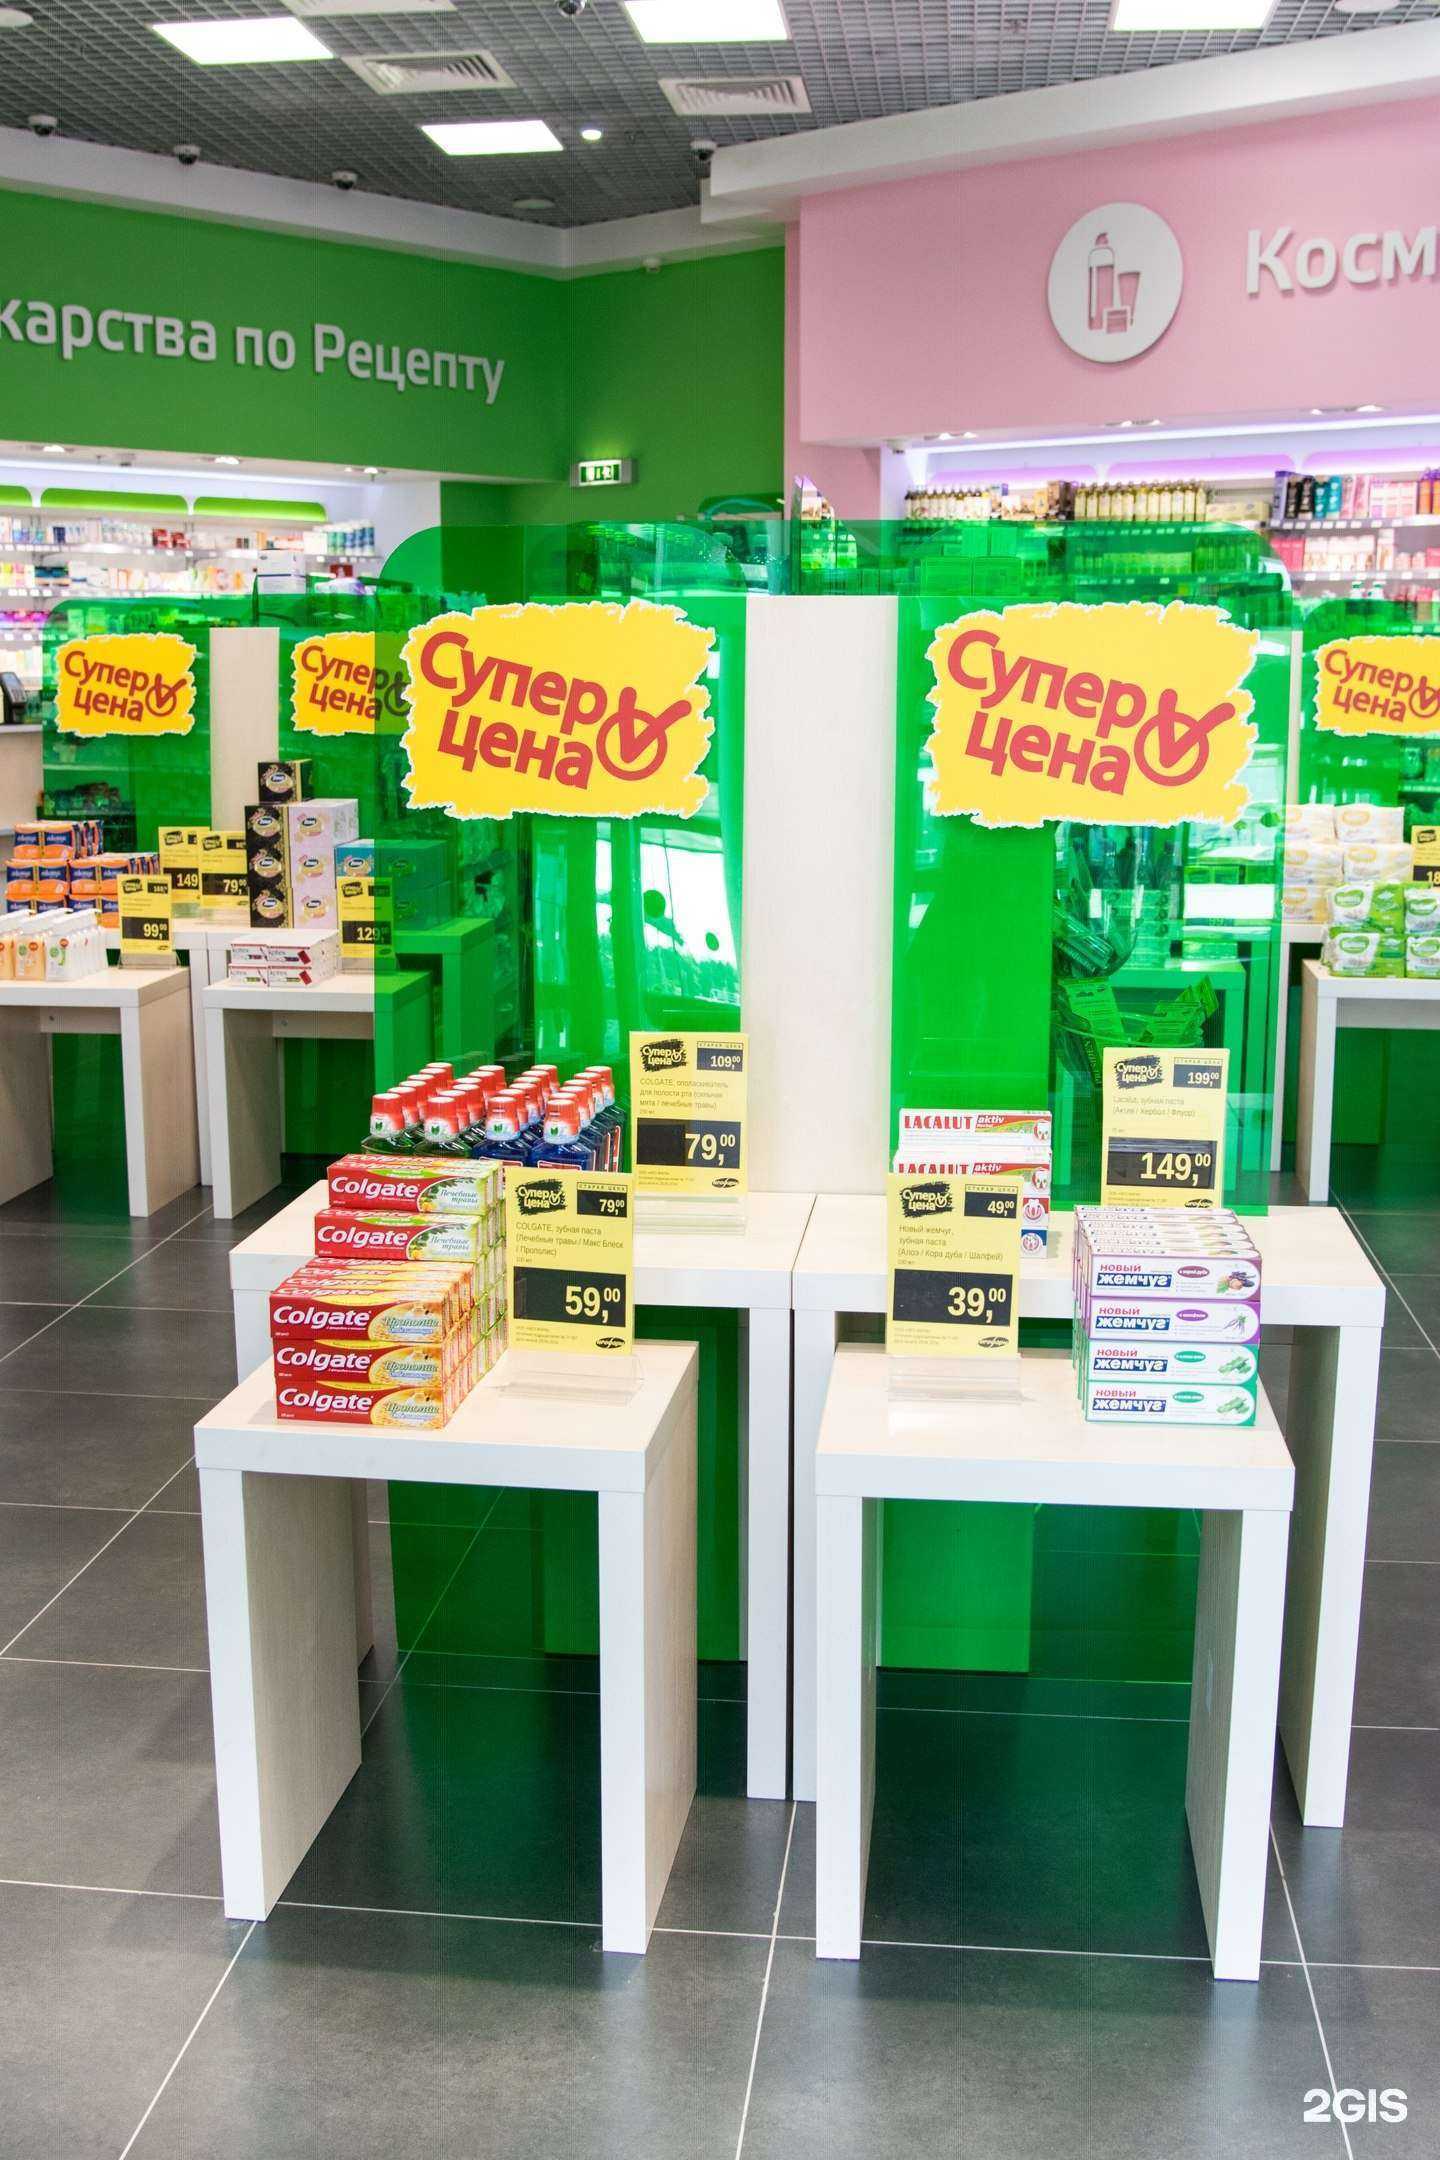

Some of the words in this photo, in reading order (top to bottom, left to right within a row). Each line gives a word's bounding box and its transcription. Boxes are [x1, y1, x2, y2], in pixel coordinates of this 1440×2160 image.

[1247, 226, 1438, 294] Косм
[235, 326, 297, 370] по
[314, 323, 505, 405] Рецепту
[64, 650, 150, 696] Супер
[301, 645, 390, 694] Супер
[1324, 649, 1414, 697] Супер
[421, 631, 608, 735] Супер
[947, 629, 1147, 738] Супер
[74, 687, 144, 722] цена
[309, 683, 384, 721] цена
[1332, 685, 1407, 723] цена
[437, 709, 594, 790] цена
[965, 711, 1132, 796] цена
[642, 1046, 672, 1059] Супер
[648, 1056, 672, 1065] цена
[1116, 1062, 1148, 1075] Супер
[904, 1115, 973, 1130] LACALUT
[977, 1115, 1005, 1124] aktiv
[685, 1133, 736, 1165] 79,00
[1140, 1152, 1212, 1186] 149,00
[331, 1176, 420, 1200] Colgate
[518, 1186, 550, 1200] Супер
[902, 1189, 937, 1202] Супер
[524, 1198, 550, 1209] цена
[599, 1199, 625, 1215] 79,00
[908, 1200, 936, 1211] цена
[987, 1200, 1015, 1216] 49,00
[317, 1225, 409, 1249] Colgate
[1097, 1273, 1169, 1287] жемчуг
[565, 1285, 621, 1323] 59,00
[948, 1286, 1006, 1323] 39,00
[273, 1305, 370, 1329] Colgate
[1096, 1317, 1167, 1329] жемчуг
[276, 1347, 371, 1371] Colgate
[1093, 1358, 1165, 1371] жемчуг
[279, 1388, 373, 1412] Colgate
[1092, 1398, 1163, 1411] жемчуг
